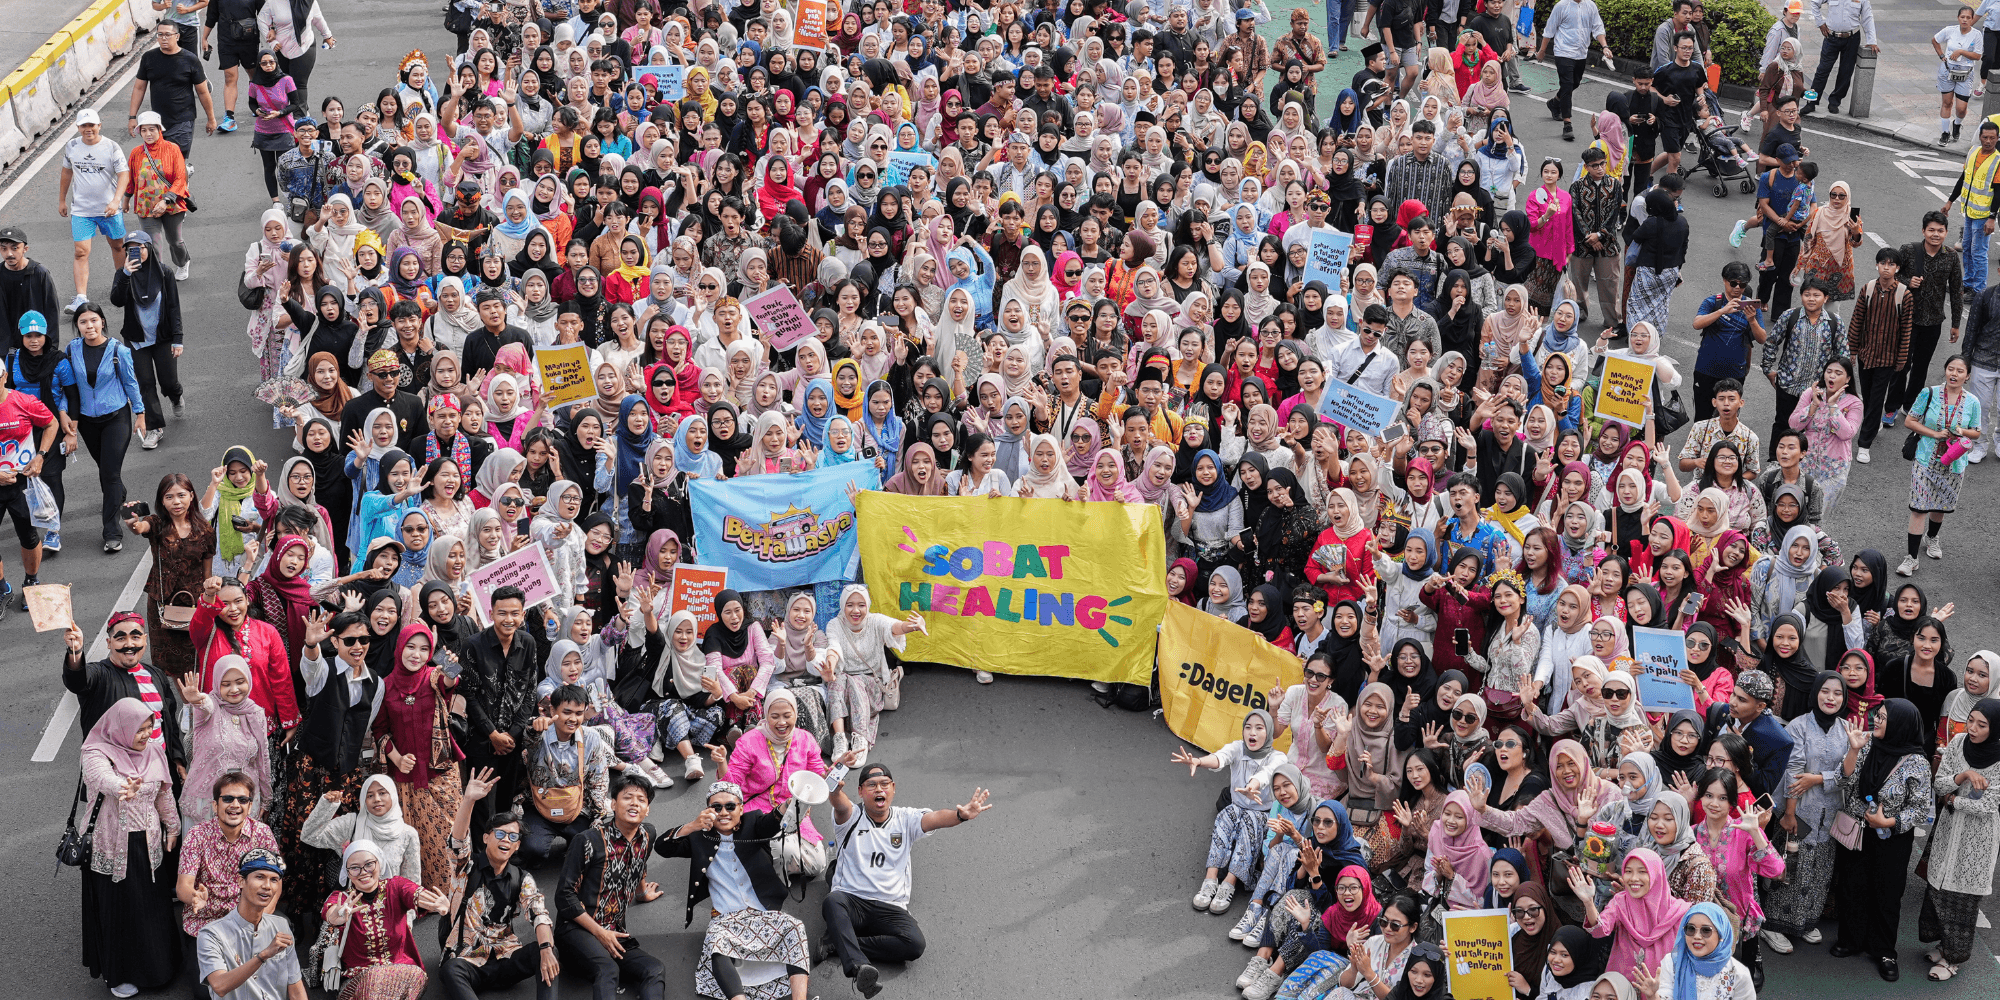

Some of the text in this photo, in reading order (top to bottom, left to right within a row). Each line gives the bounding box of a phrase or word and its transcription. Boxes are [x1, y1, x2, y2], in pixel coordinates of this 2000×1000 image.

[761, 300, 783, 311] Toxic
[770, 312, 789, 322] RUN
[545, 360, 580, 371] Maafin ya
[571, 376, 585, 385] hati
[1611, 372, 1634, 381] Maafin
[1606, 392, 1640, 405] dalam hati
[725, 513, 852, 558] Bertawasya
[922, 540, 1070, 581] SOBAT
[479, 561, 517, 586] Perempuan
[497, 561, 537, 585] Saling Jaga,
[681, 579, 720, 588] Perempuan
[687, 588, 712, 596] Berani,
[681, 594, 715, 604] Wujudka
[899, 581, 1107, 629] HEALING
[1645, 665, 1678, 677] is pain
[1179, 662, 1268, 711] :Dagela
[870, 852, 885, 868] 10
[1455, 939, 1502, 950] Untungnya
[1484, 952, 1503, 961] Pilih
